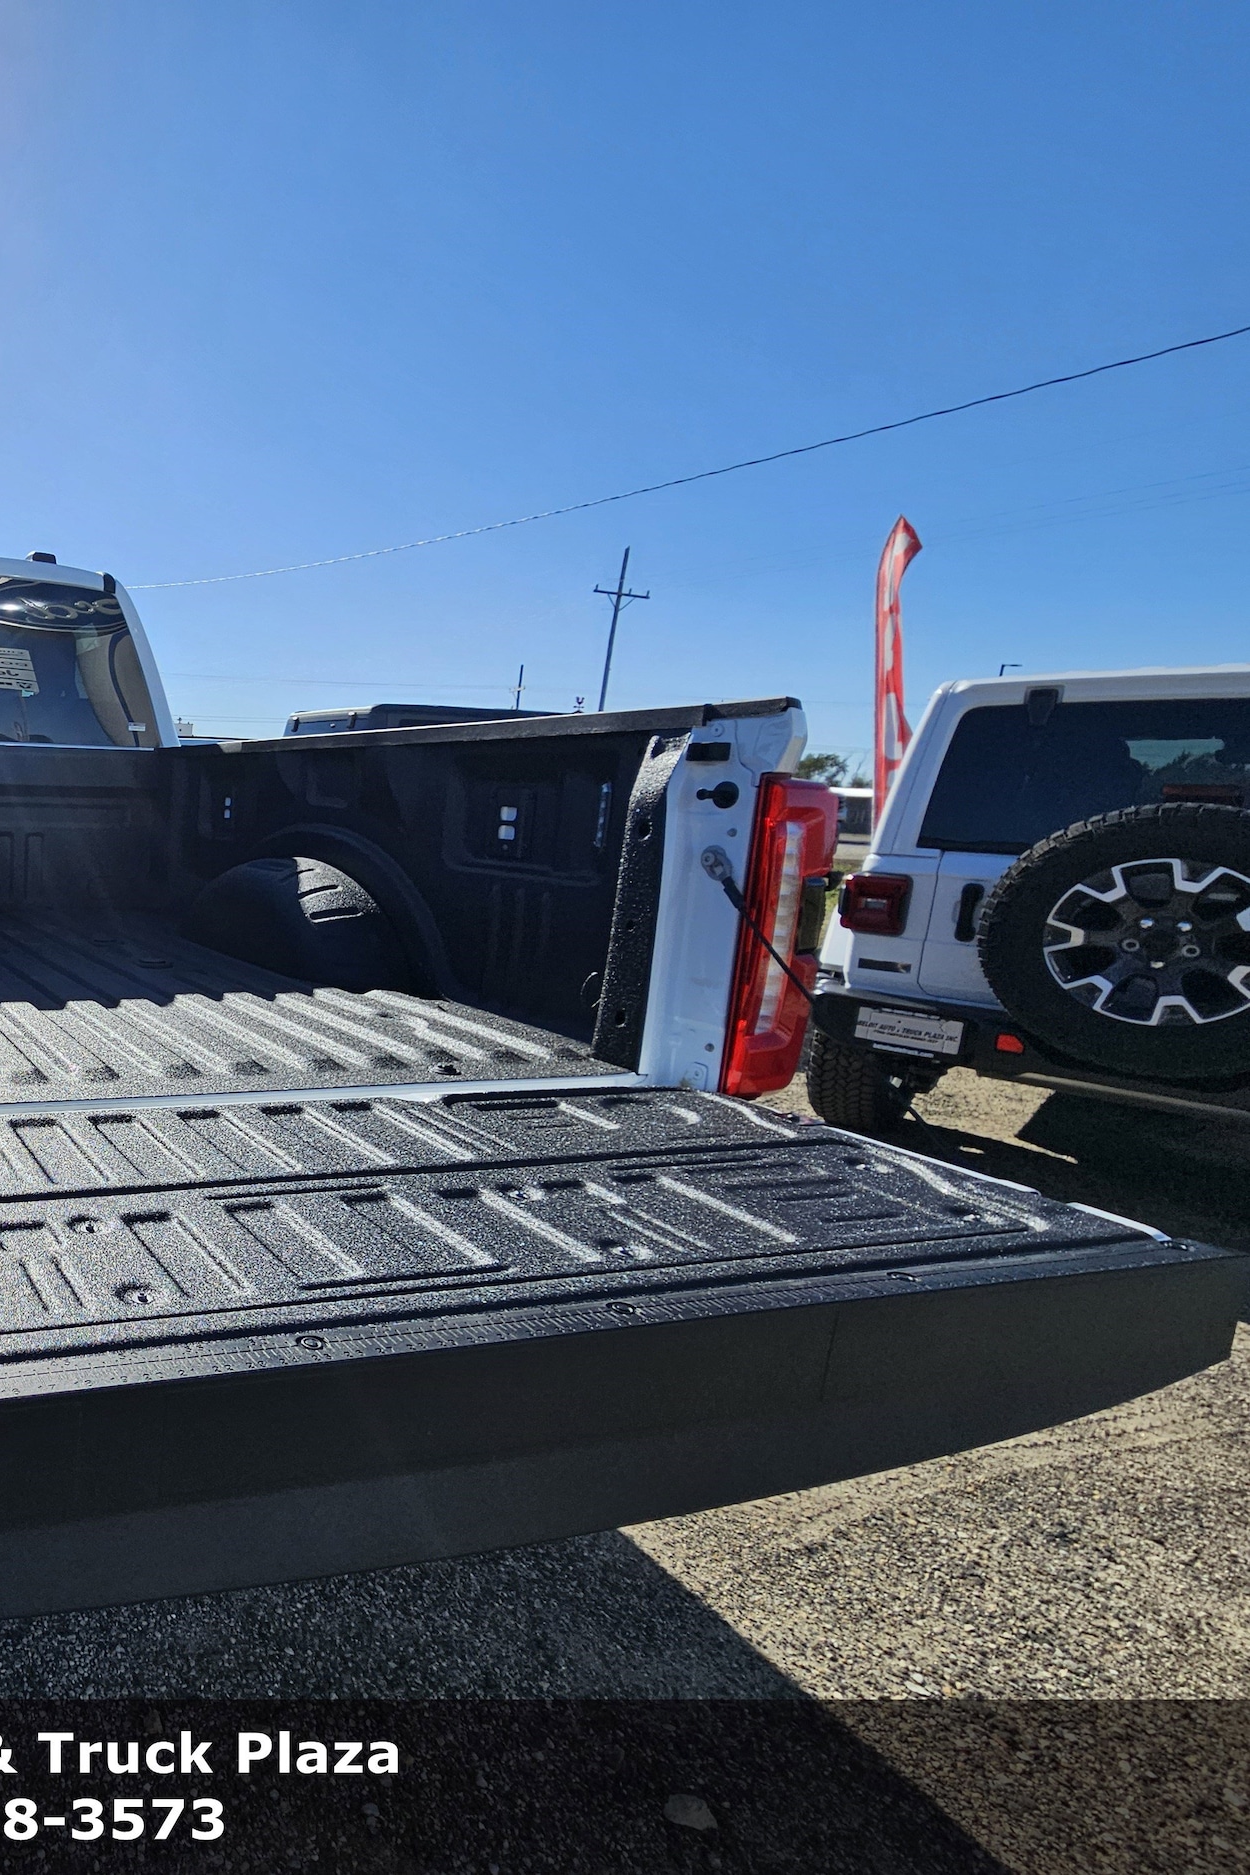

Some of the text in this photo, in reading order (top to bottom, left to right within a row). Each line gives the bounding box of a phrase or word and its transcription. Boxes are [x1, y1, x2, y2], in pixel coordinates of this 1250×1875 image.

[879, 1024, 896, 1032] AUTO
[902, 1027, 923, 1036] TRUCK
[923, 1031, 945, 1040] PLAZA
